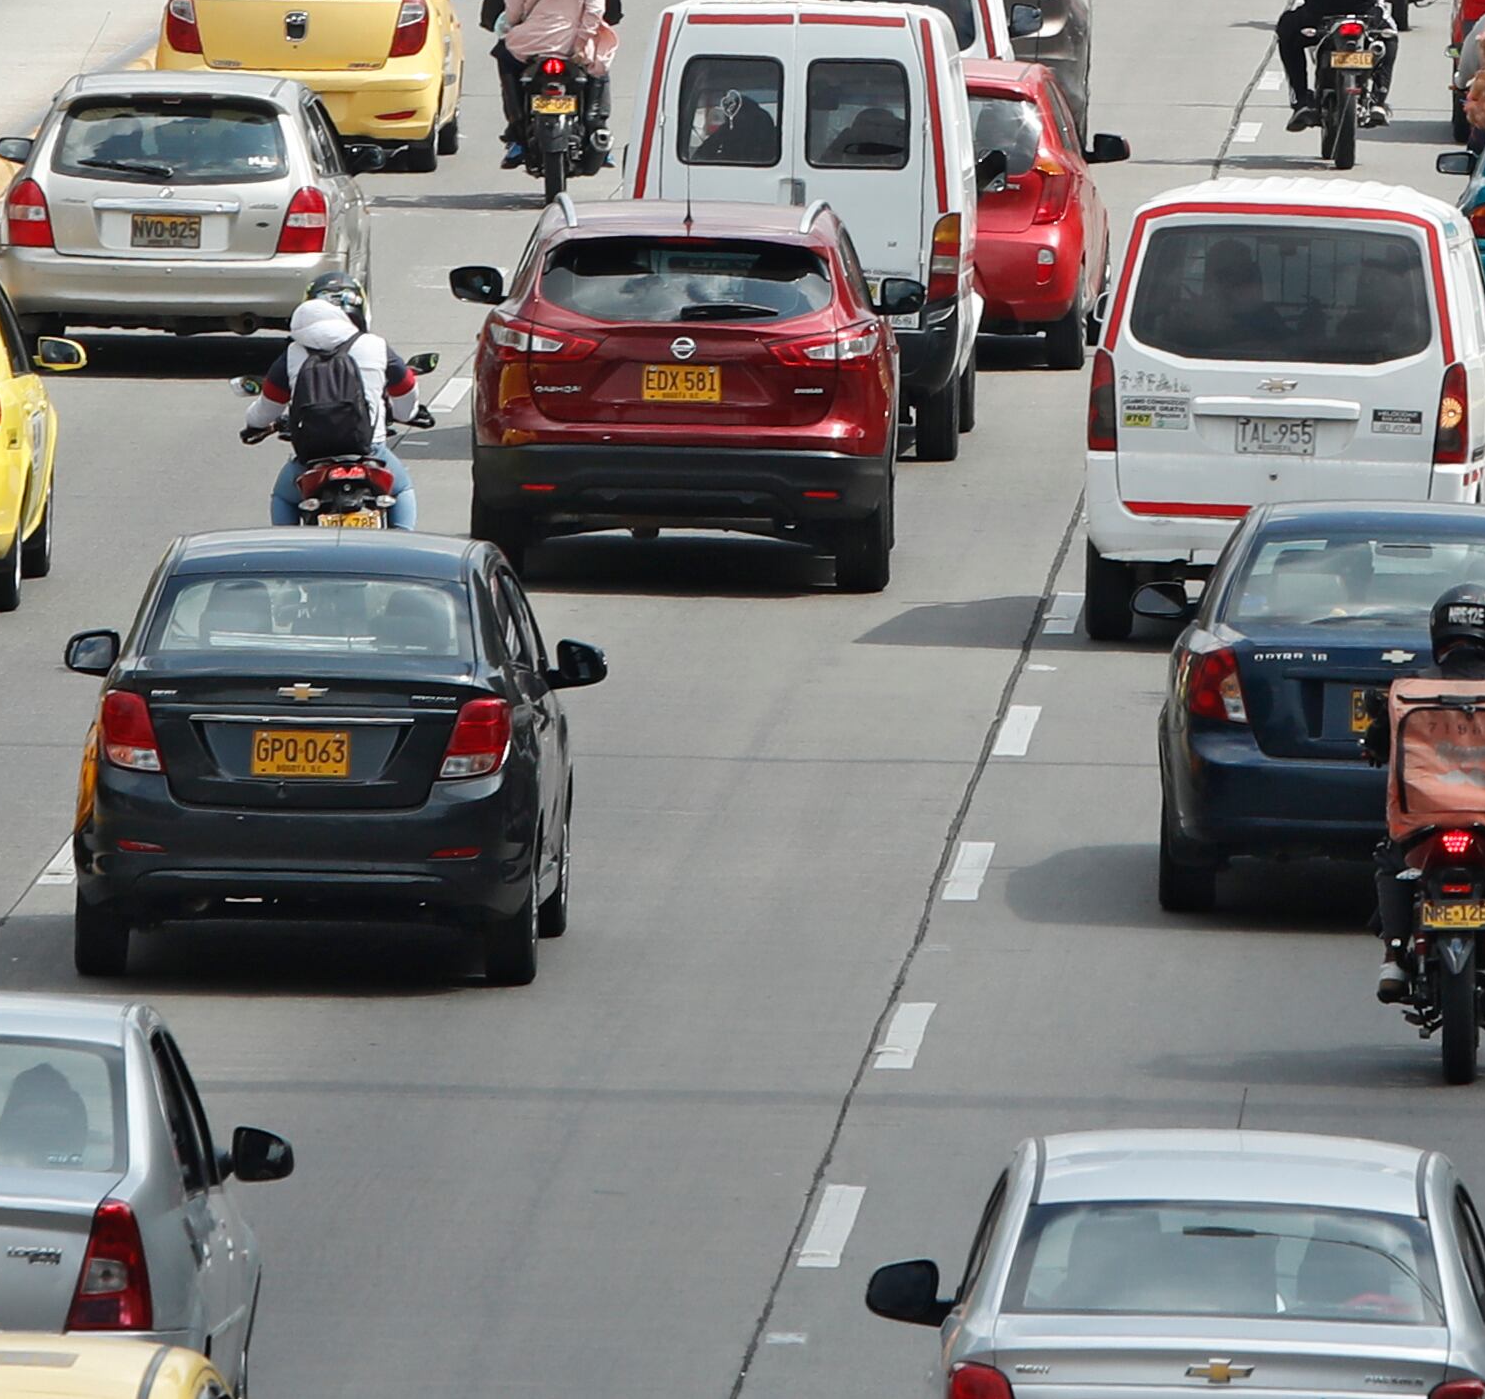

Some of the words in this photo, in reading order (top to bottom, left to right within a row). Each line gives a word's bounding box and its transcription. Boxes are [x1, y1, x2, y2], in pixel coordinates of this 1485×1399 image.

[644, 367, 682, 391] EDX
[685, 369, 719, 392] 581
[6, 1245, 62, 1258] LOGAN
